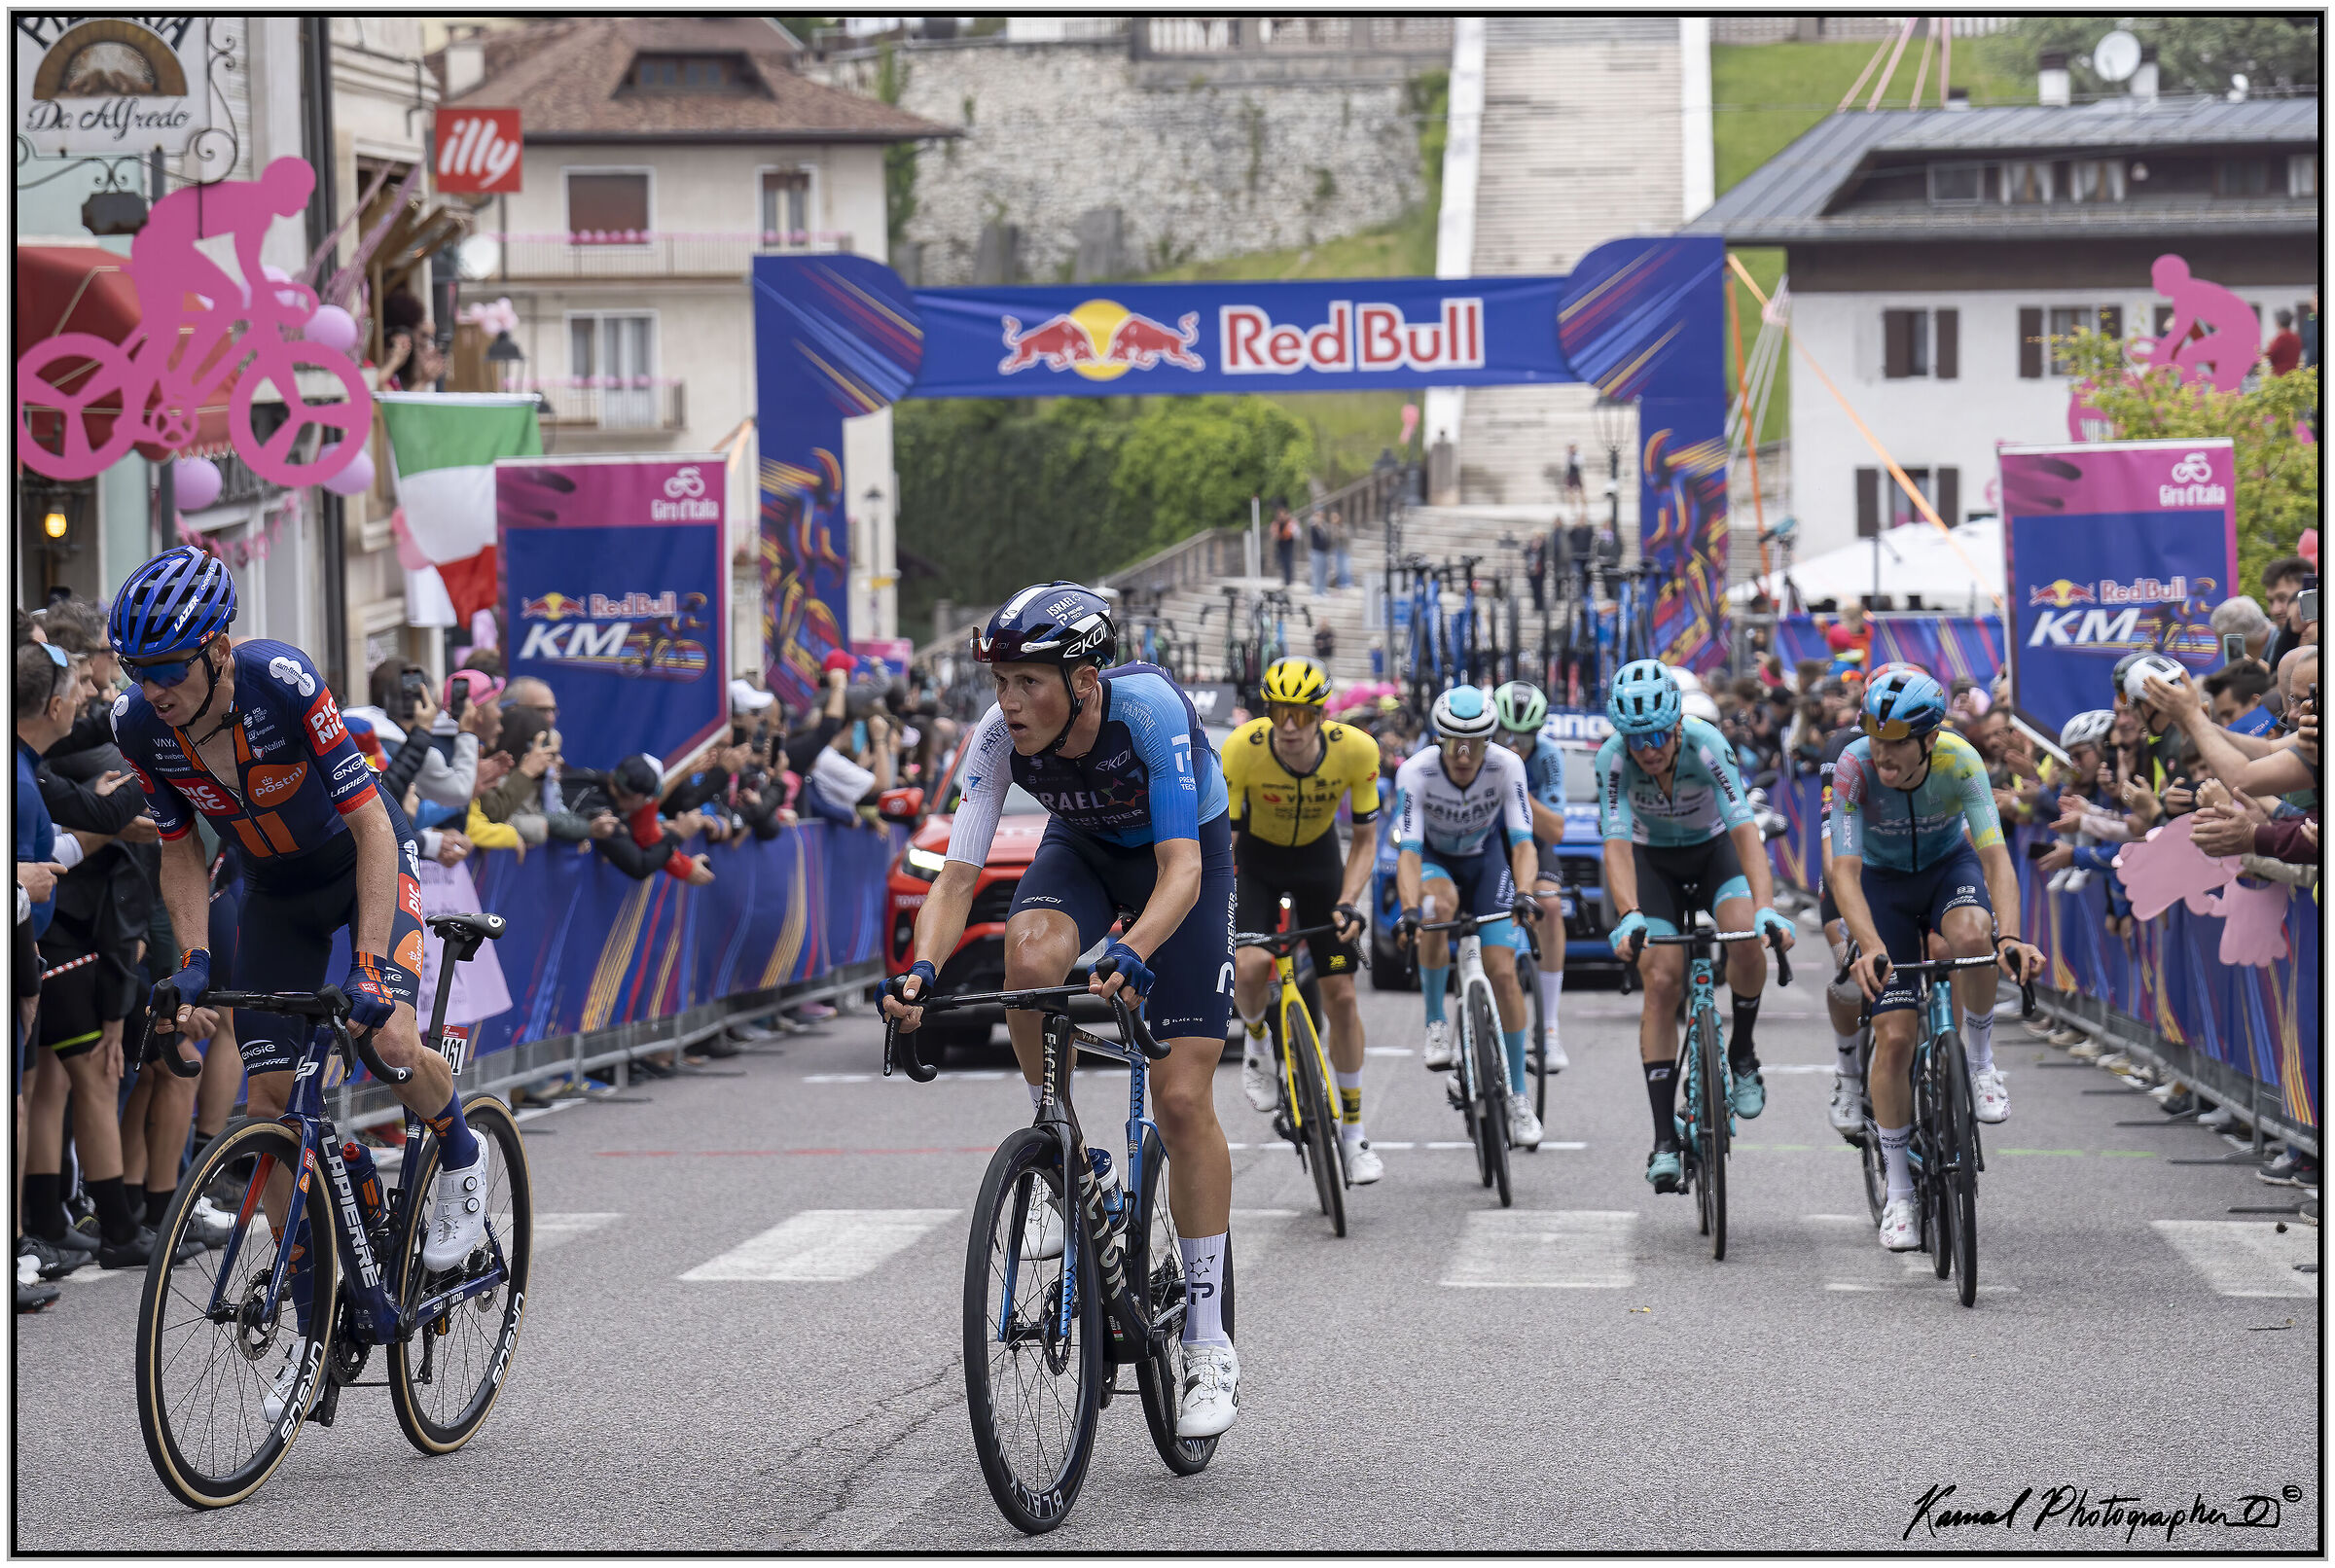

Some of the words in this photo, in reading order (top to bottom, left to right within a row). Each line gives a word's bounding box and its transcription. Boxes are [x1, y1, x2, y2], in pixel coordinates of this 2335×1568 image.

[80, 97, 193, 141] Alfredo
[439, 118, 520, 189] illy
[173, 595, 199, 632] LAZER
[1046, 596, 1077, 618] ISRAEL
[2028, 608, 2140, 647] KM
[519, 623, 631, 659] KM
[264, 737, 286, 753] Nalini
[443, 1037, 463, 1075] 161
[1042, 1032, 1058, 1106] FACTOR
[321, 1134, 379, 1289] LAPIERRE
[491, 1292, 526, 1390] URSUS
[277, 1340, 324, 1444] URSUS
